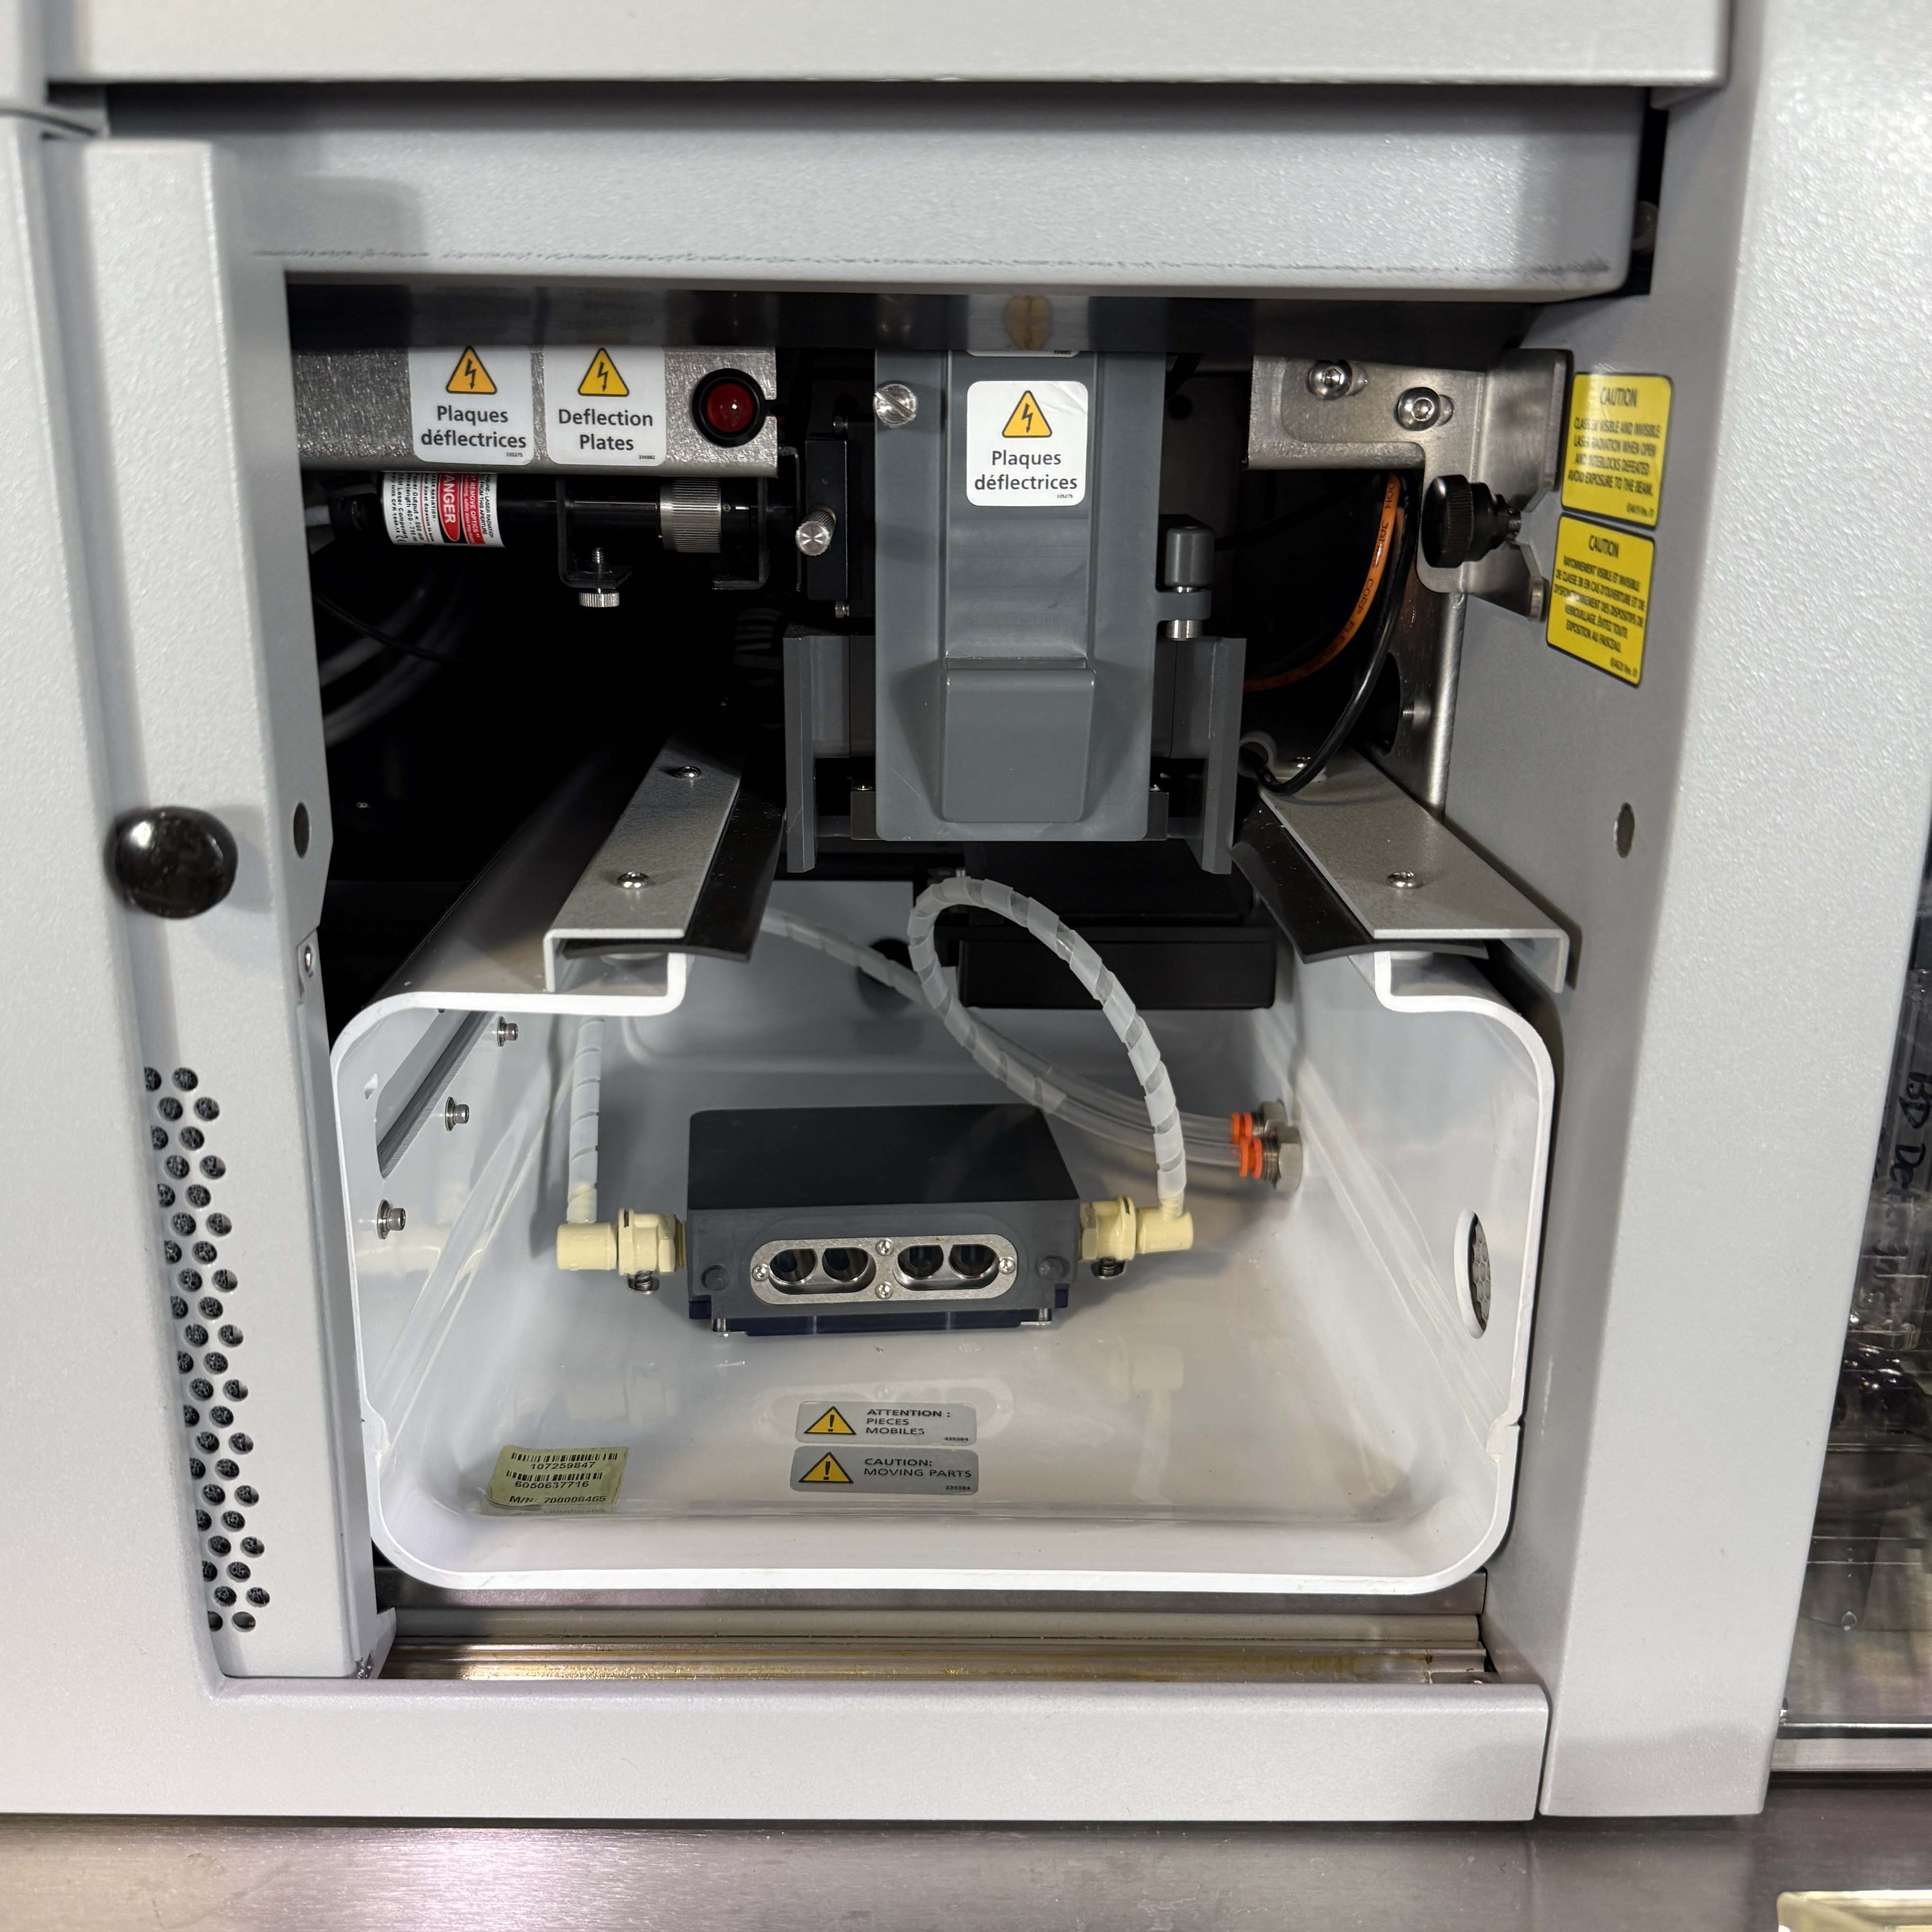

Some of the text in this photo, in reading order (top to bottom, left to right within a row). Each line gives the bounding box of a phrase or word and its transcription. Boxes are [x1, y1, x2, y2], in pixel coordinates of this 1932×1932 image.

[1600, 387, 1637, 407] CAUTION
[437, 405, 509, 426] Plaques
[559, 409, 653, 427] Deflection
[421, 429, 527, 448] déflectrices
[580, 434, 634, 451] Plates
[992, 449, 1062, 469] Plaques
[974, 474, 1078, 491] déflectrices
[443, 474, 456, 524] ANGER
[398, 508, 409, 538] Component
[1588, 534, 1619, 557] CAUTION
[1357, 578, 1373, 615] CORP
[866, 1408, 942, 1417] ATTENTION
[866, 1427, 924, 1435] MOBILES
[530, 1461, 596, 1469] 107259847
[864, 1458, 932, 1467] CAUTION:
[864, 1468, 972, 1477] MOVING PARTS
[515, 1481, 590, 1489] 6050637716
[509, 1495, 607, 1503] M/N: 700000465
